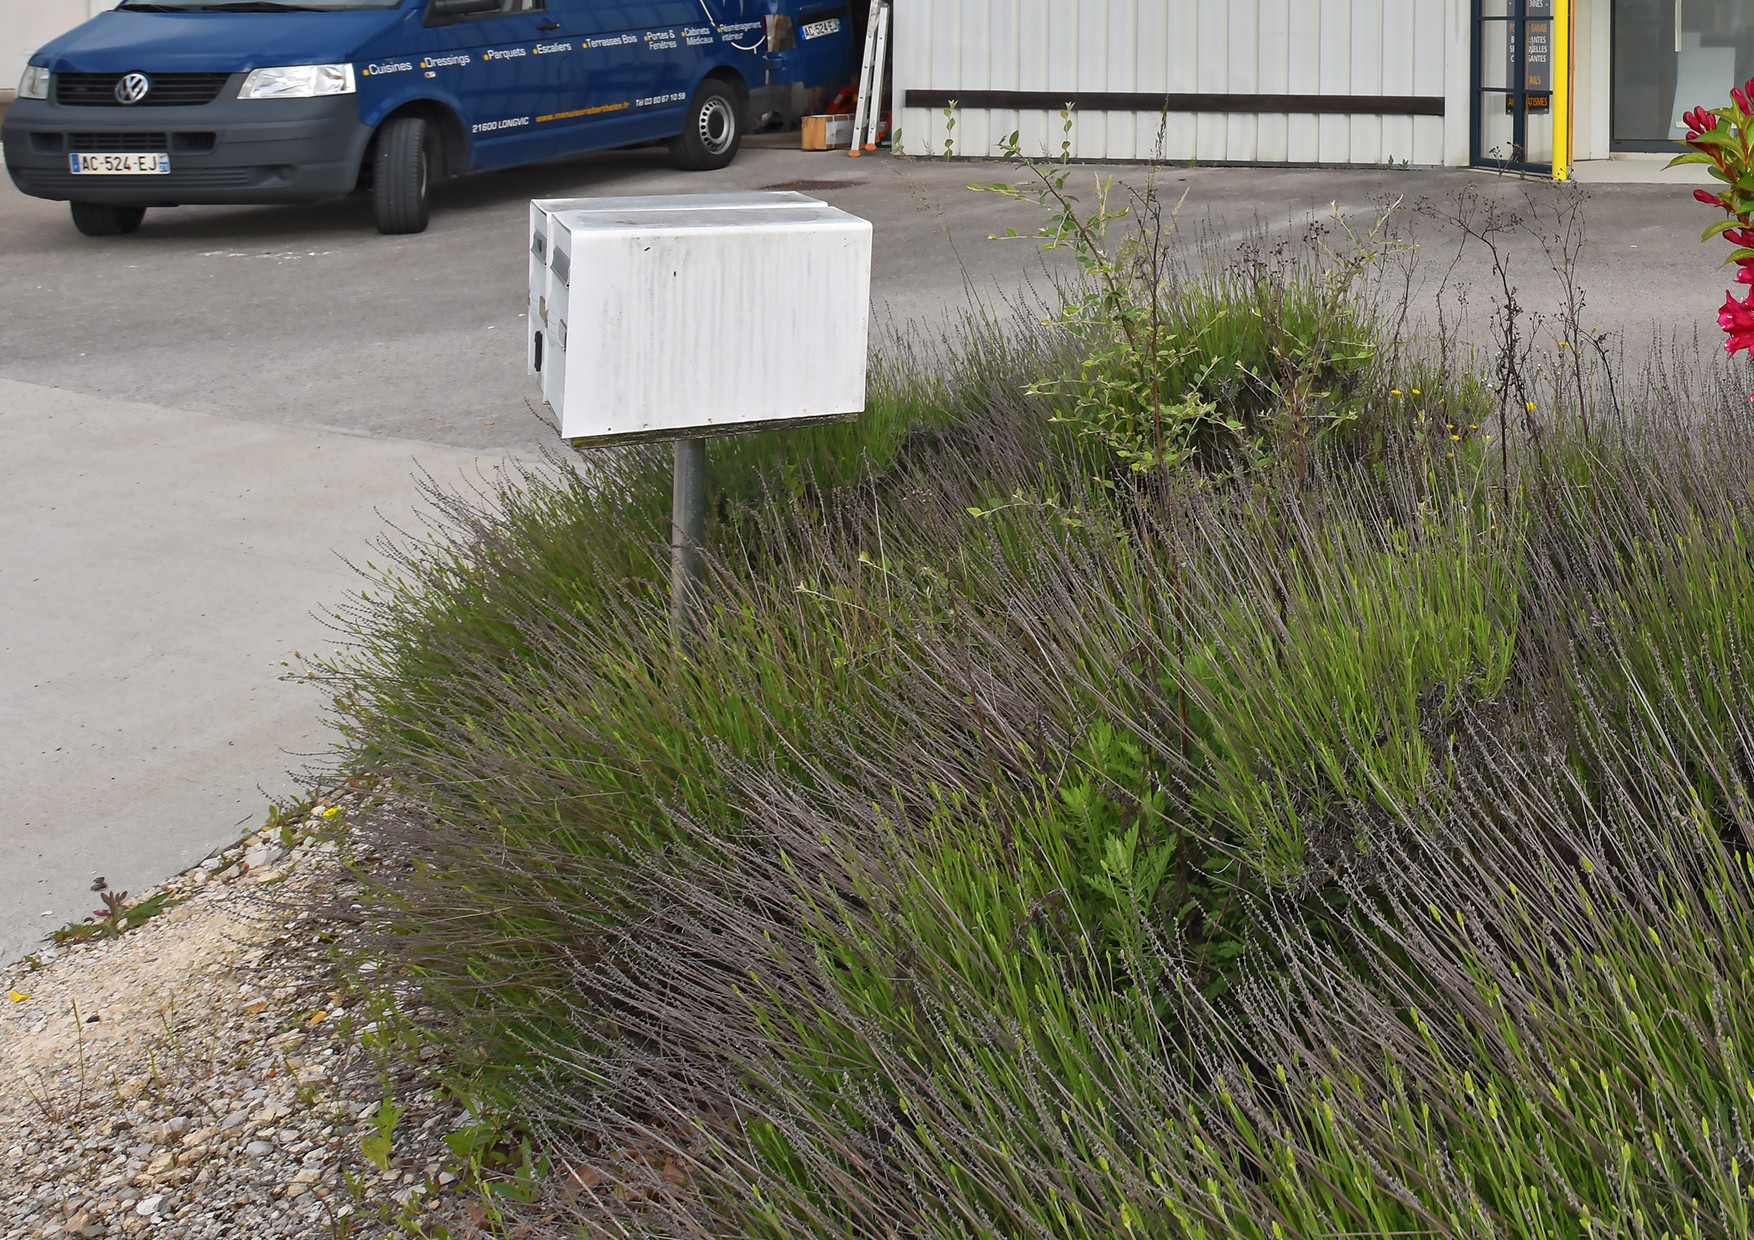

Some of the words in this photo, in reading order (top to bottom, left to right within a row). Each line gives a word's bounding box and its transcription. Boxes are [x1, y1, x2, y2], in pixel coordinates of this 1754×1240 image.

[647, 31, 668, 40] Portes
[668, 29, 675, 38] &
[684, 27, 710, 36] Cabinets
[586, 35, 622, 48] Terrasses
[622, 34, 638, 44] Bois
[649, 39, 677, 50] Fenêtres
[686, 36, 714, 46] Médicaux
[487, 47, 526, 60] Parquets
[536, 42, 572, 54] Escaliers
[424, 55, 471, 68] Dressings
[368, 62, 413, 75] Cuisines
[472, 121, 497, 133] 21600
[498, 117, 529, 128] LONGVIC
[82, 156, 157, 171] AC-524-EJ
